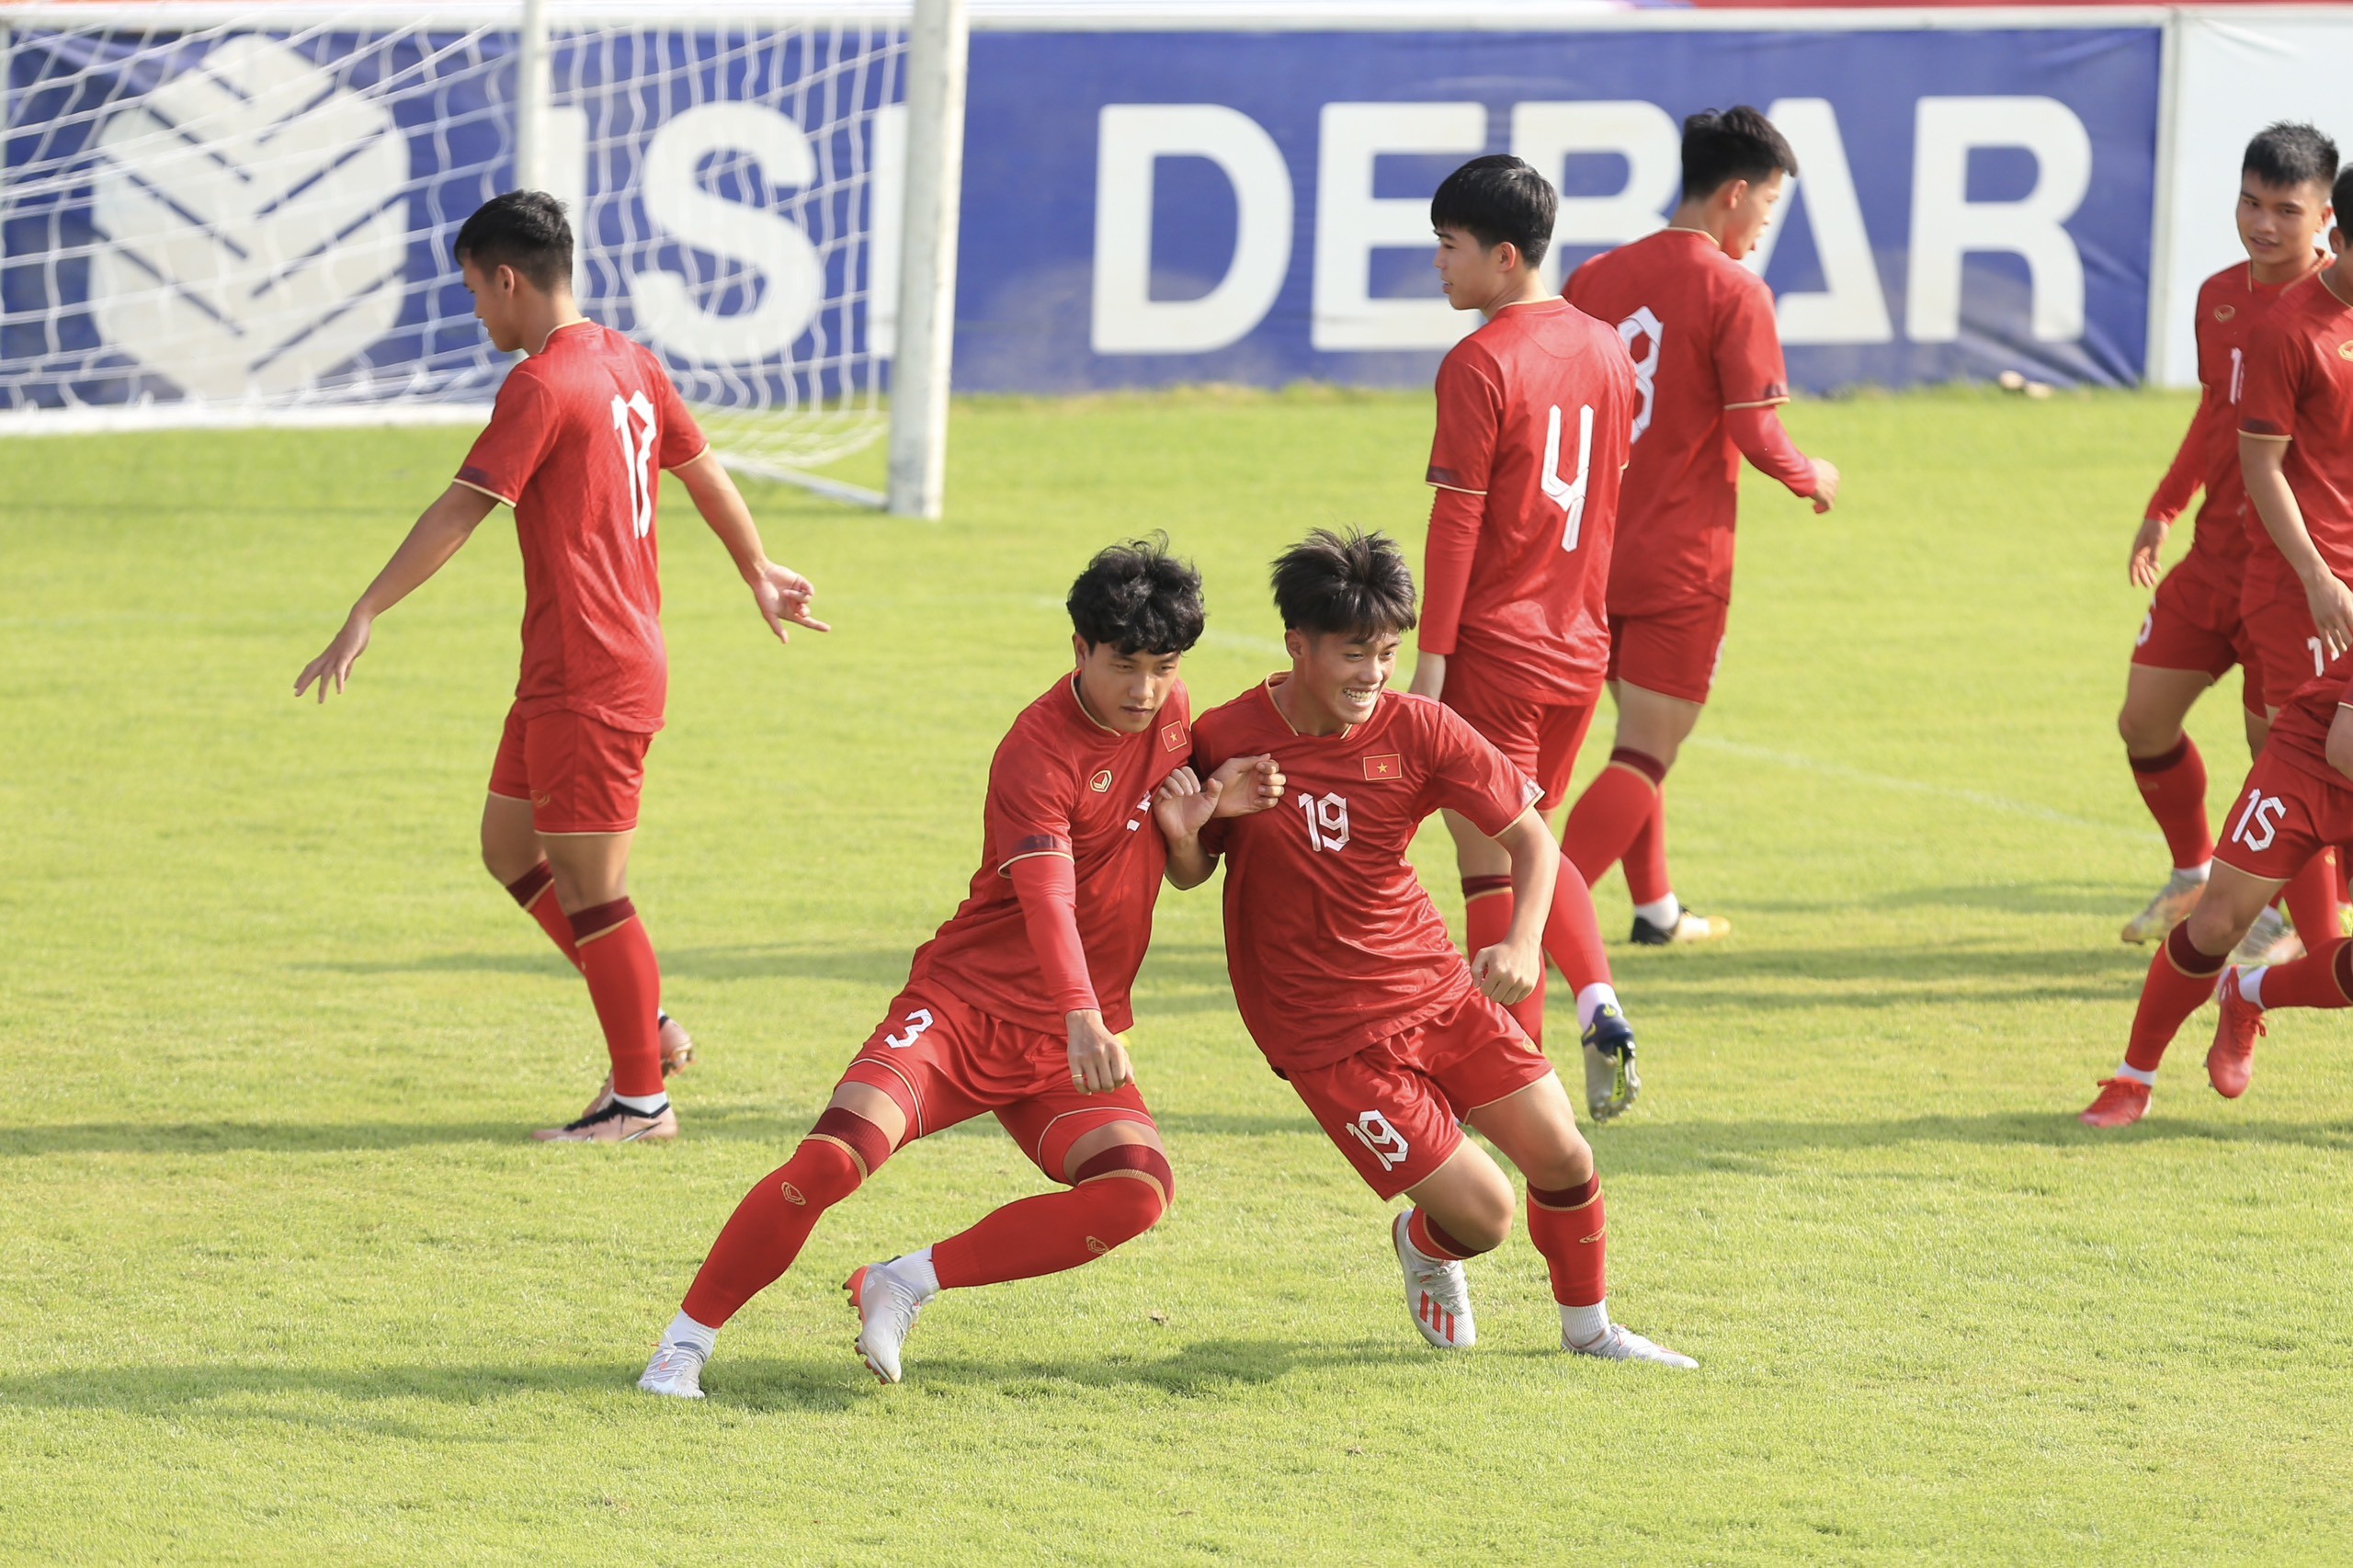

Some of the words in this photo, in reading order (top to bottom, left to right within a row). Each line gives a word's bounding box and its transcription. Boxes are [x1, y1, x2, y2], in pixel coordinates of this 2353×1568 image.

[1091, 95, 2093, 355] DEBAR
[1540, 403, 1595, 552] 4
[1298, 791, 1350, 852] 19
[2231, 788, 2287, 852] 15
[883, 1007, 934, 1050] 3
[1345, 1108, 1409, 1172] 19
